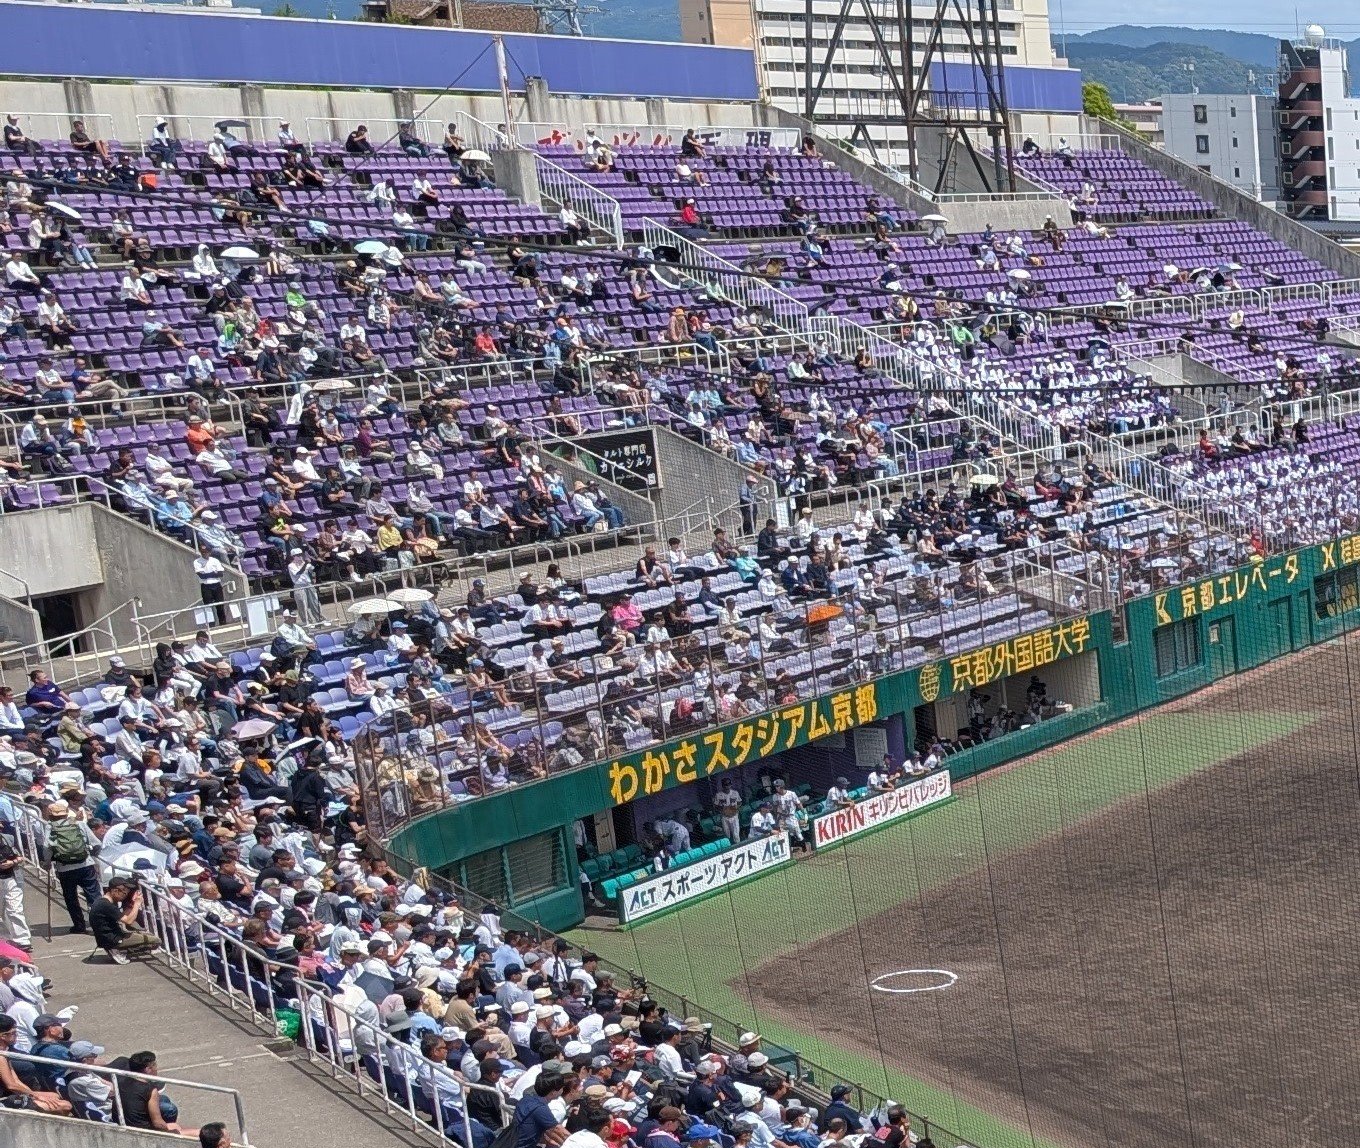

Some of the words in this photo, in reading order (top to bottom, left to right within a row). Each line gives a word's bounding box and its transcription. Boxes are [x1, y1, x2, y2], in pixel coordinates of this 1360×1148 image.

[951, 616, 1090, 693] 京都外国語大学
[609, 683, 877, 804] わかさスタジアム京都
[817, 806, 865, 842] KIRIN
[869, 775, 948, 822] キリンビバレッジ
